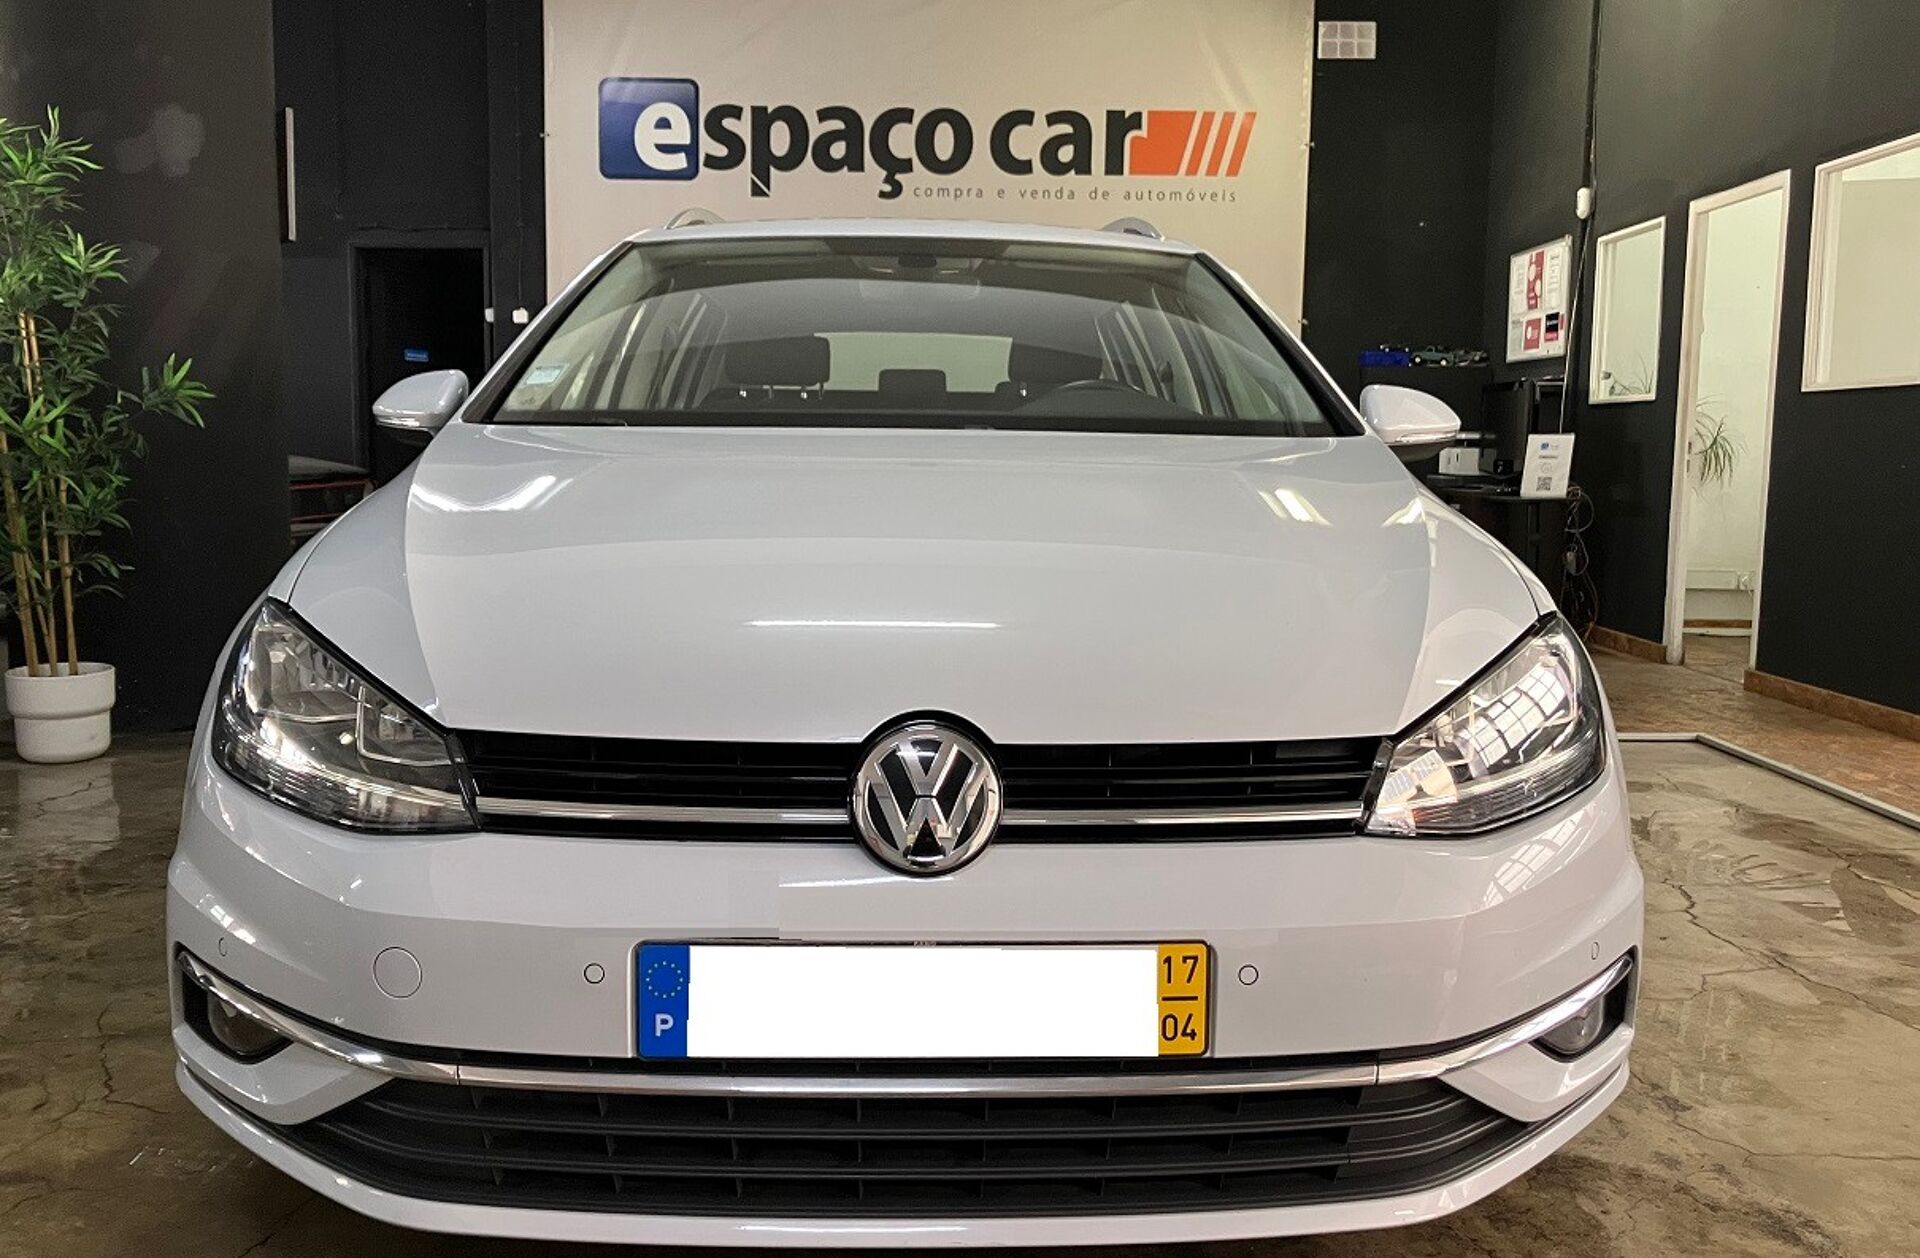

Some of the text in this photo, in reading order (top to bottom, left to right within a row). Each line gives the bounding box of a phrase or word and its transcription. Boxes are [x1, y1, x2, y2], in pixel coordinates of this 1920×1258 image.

[633, 101, 1143, 200] espaço car
[912, 186, 1237, 202] compra e venda de automóveis
[859, 731, 995, 864] VW
[1162, 955, 1199, 984] 17
[654, 1012, 674, 1037] P
[1161, 1012, 1197, 1042] 04
